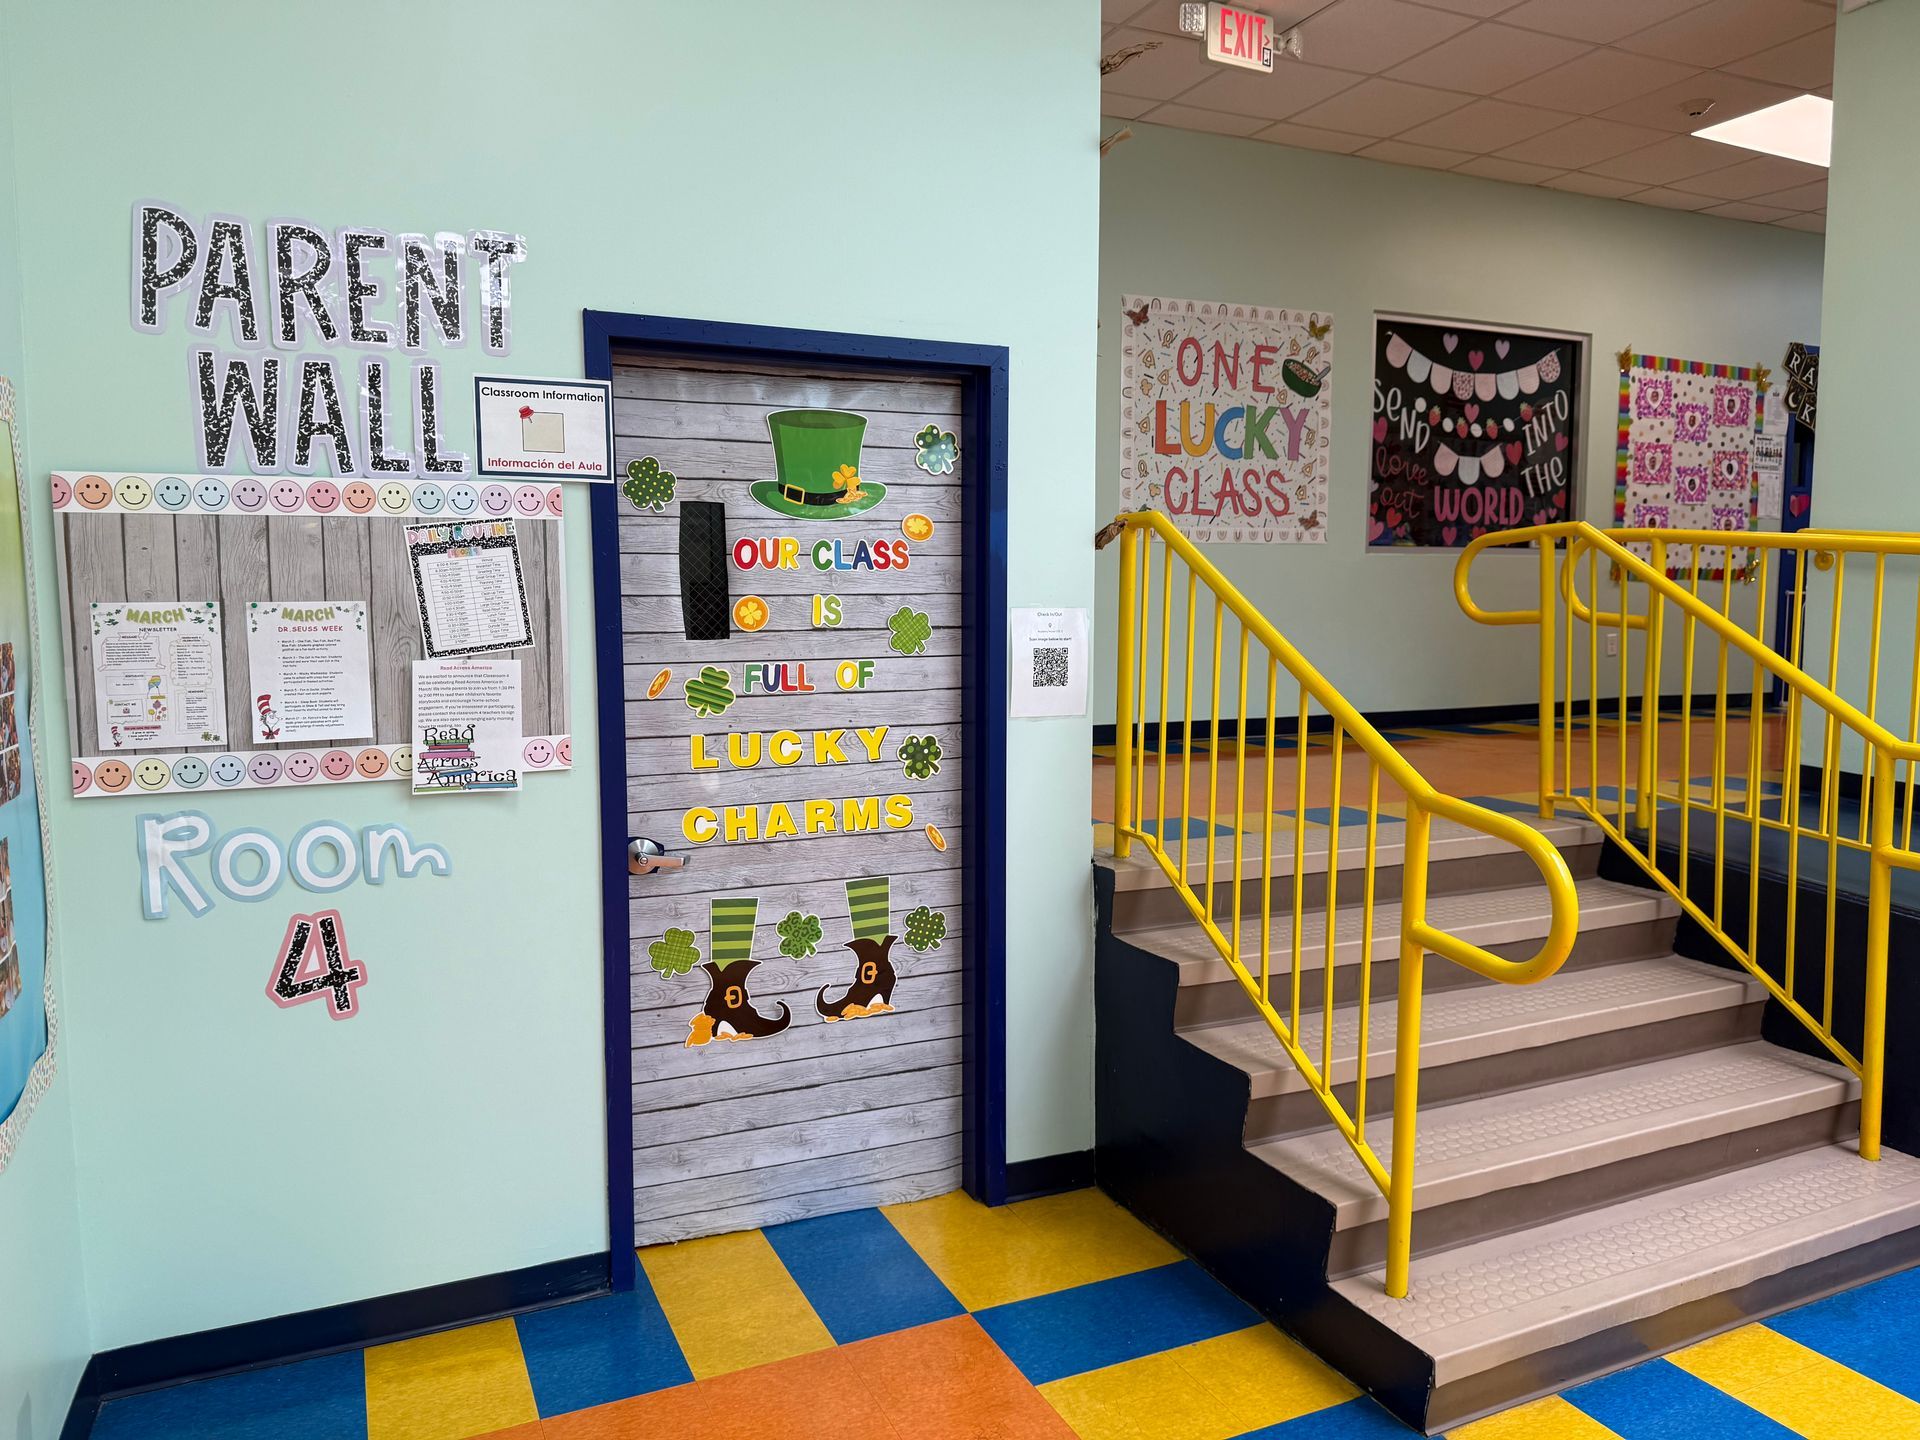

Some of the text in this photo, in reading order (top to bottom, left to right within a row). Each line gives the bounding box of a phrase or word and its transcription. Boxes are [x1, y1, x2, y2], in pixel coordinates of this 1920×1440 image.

[1221, 7, 1266, 62] EXIT
[141, 207, 520, 349] PARENT
[1177, 336, 1279, 394] ONE
[197, 350, 465, 474] WALL
[481, 386, 604, 403] Classroom Information
[1154, 399, 1310, 463] LUCKY
[1521, 389, 1569, 457] INTO
[487, 457, 603, 471] Información del Aula
[1163, 466, 1291, 517] CLASS
[1433, 485, 1525, 526] WORLD
[406, 521, 515, 545] DAILY ROUTINE
[732, 537, 911, 571] OUR CLASS
[126, 607, 185, 624] MARCH
[281, 606, 335, 622] MARCH
[812, 594, 843, 627] IS
[743, 660, 876, 694] FULL OF
[422, 724, 476, 746] Read
[690, 726, 890, 770] LUCKY
[417, 756, 481, 772] Across
[426, 769, 518, 788] America
[681, 794, 914, 843] CHARMS
[273, 915, 360, 1012] 4
